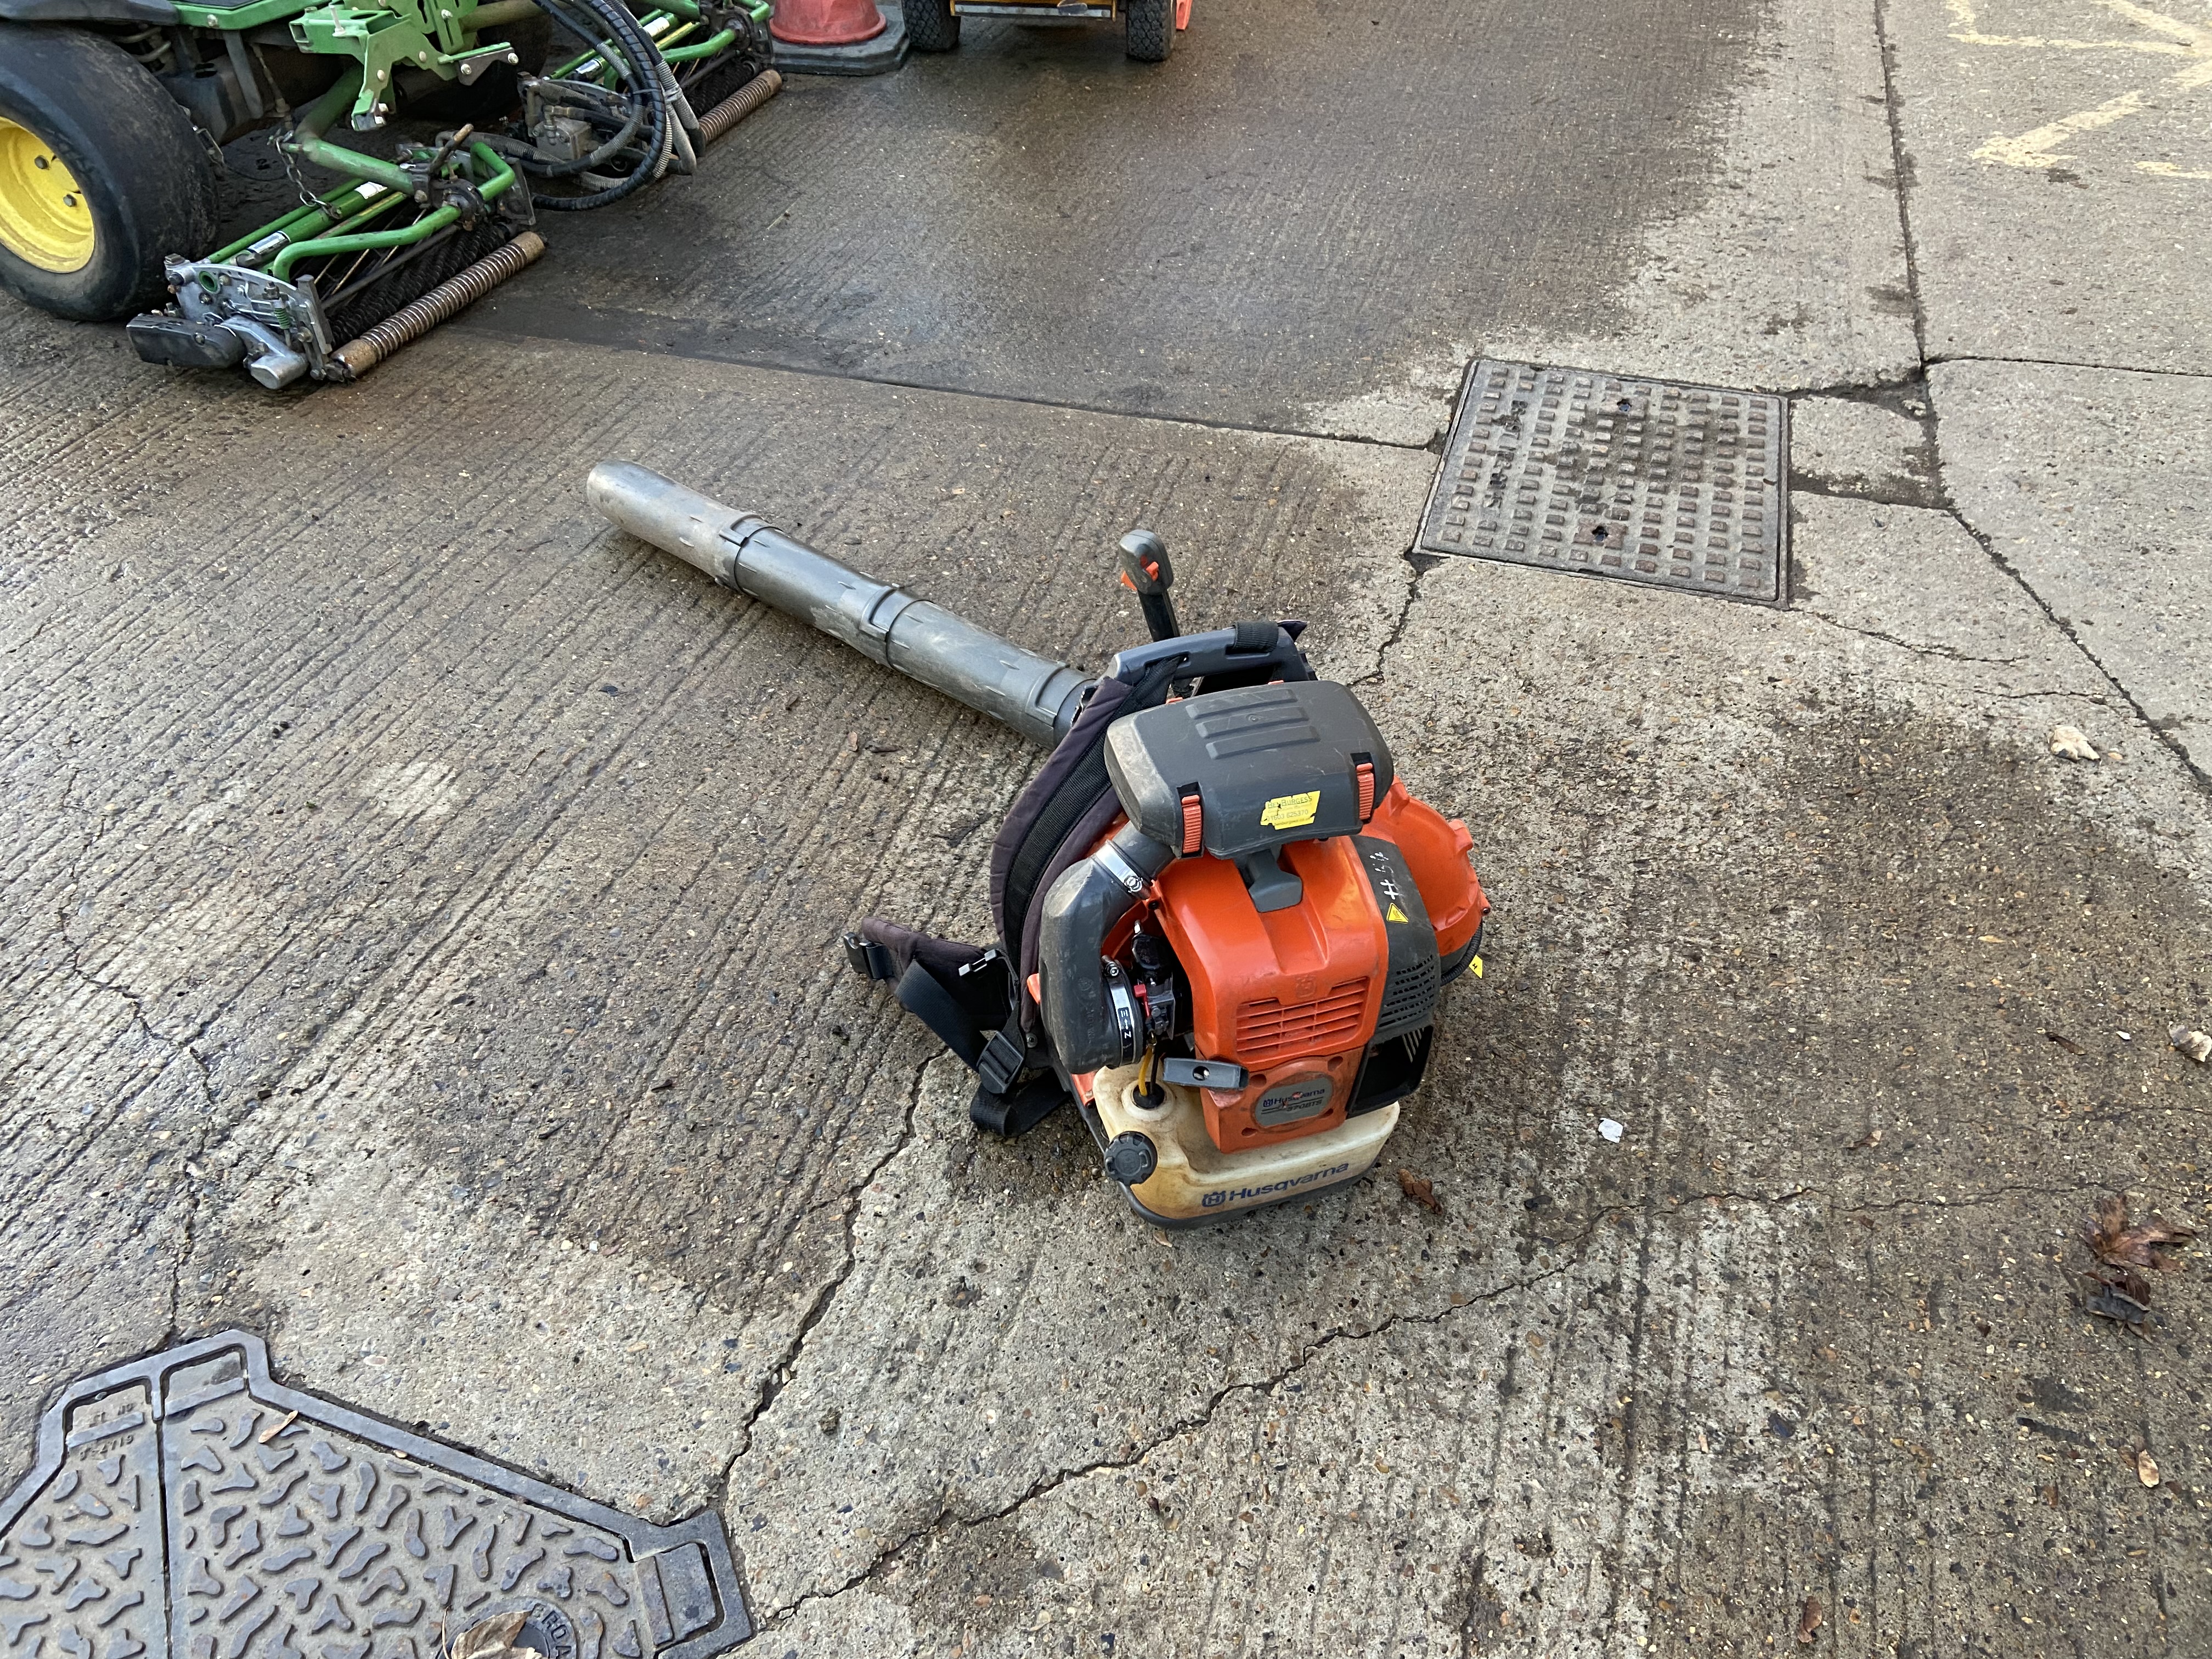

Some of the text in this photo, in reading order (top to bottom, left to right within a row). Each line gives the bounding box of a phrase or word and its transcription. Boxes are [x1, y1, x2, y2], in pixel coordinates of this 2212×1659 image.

[1282, 796, 1312, 806] BURGESS
[1286, 809, 1308, 819] 625370
[1274, 1088, 1325, 1105] Husarna
[1229, 1163, 1349, 1201] Husqvarna
